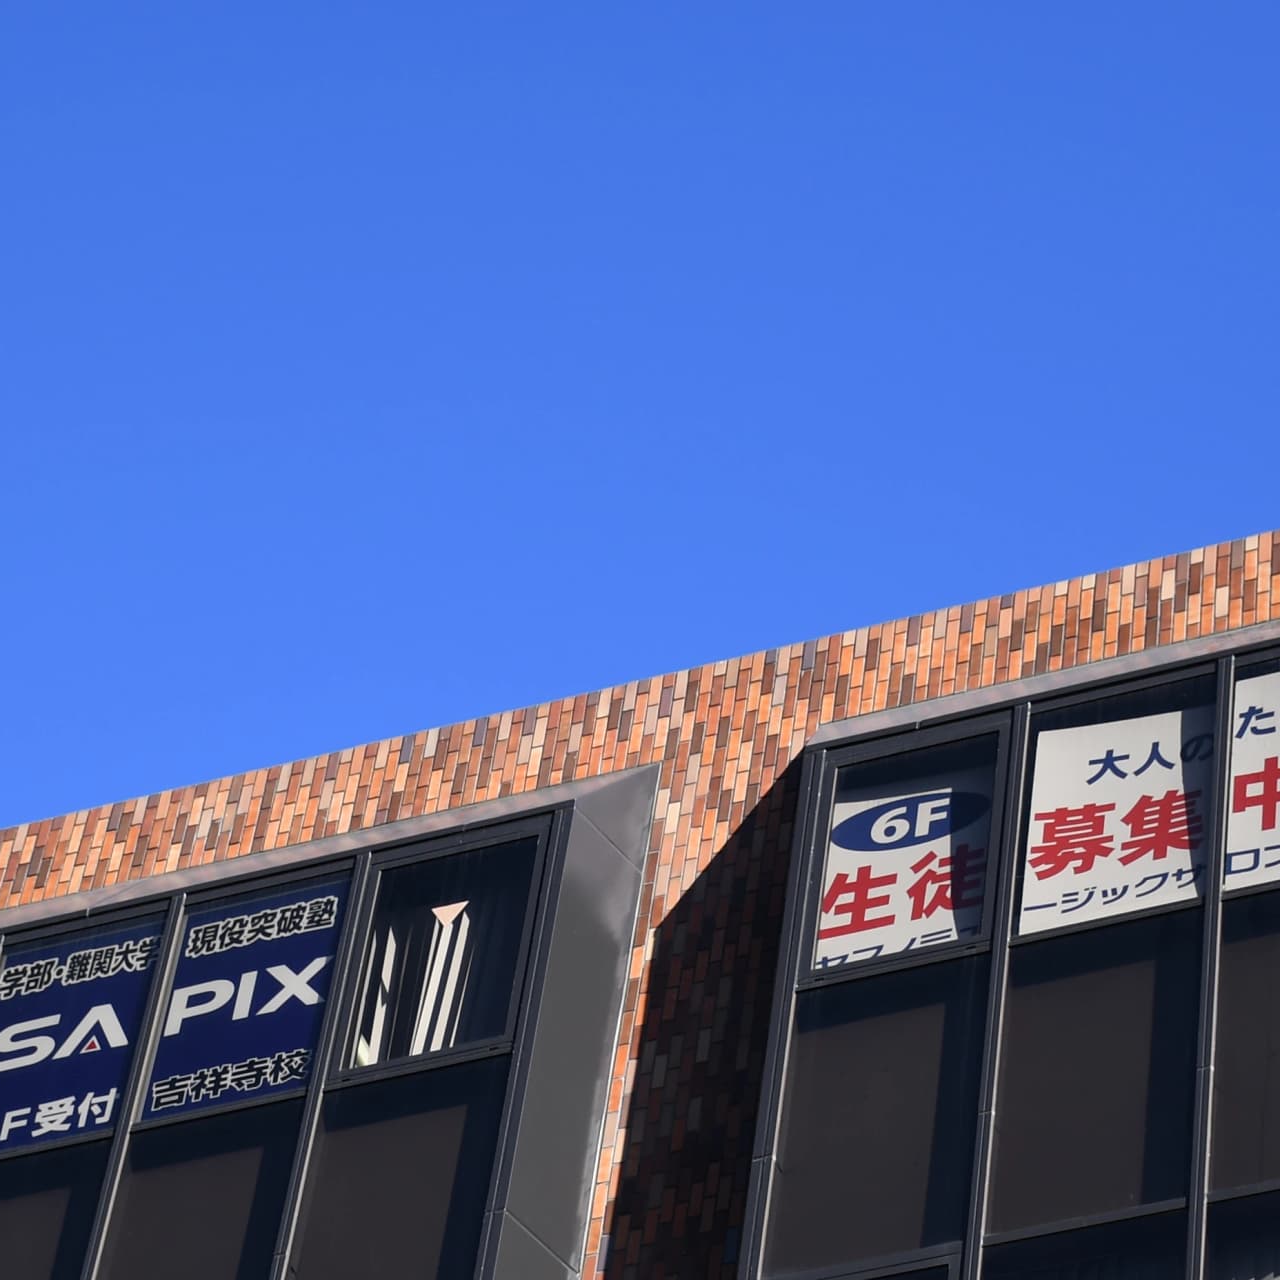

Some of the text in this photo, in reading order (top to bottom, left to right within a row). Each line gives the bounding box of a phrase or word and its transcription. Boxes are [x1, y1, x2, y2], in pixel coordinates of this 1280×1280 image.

[870, 797, 951, 844] 6F
[185, 896, 339, 957] 現役突破塾
[151, 1048, 313, 1111] 吉祥寺校
